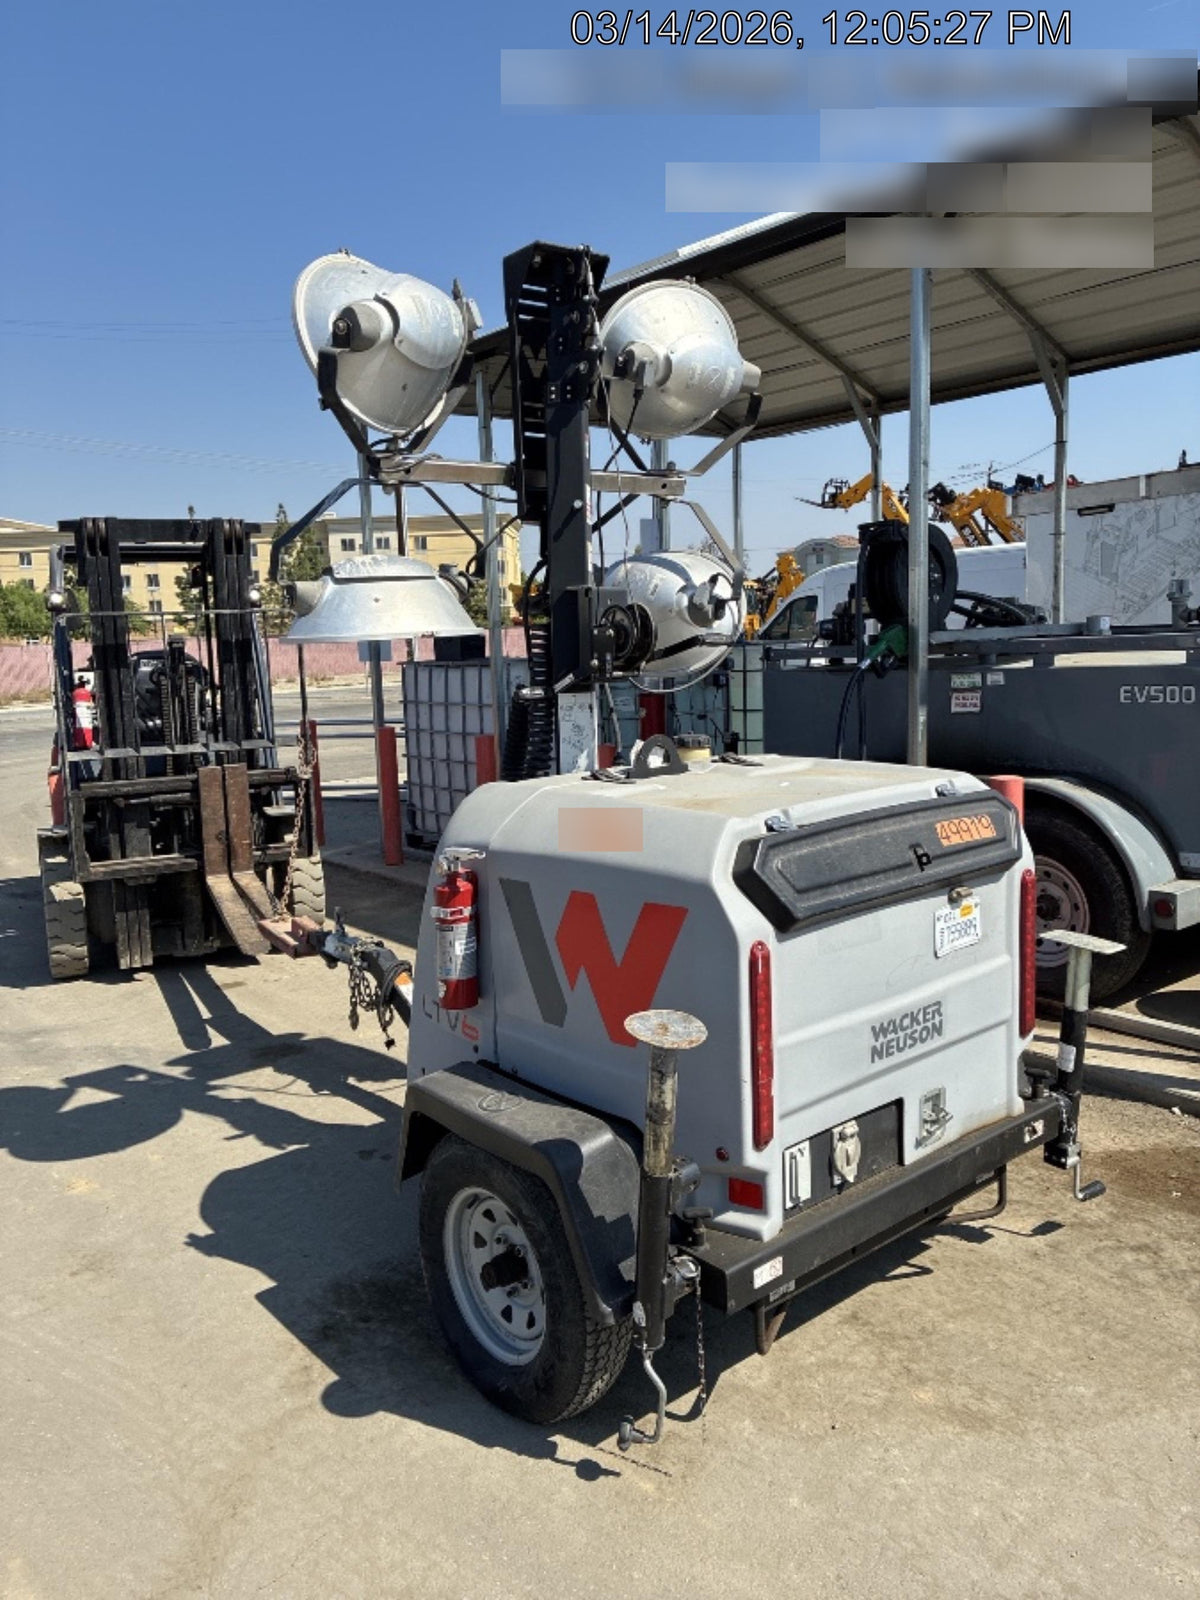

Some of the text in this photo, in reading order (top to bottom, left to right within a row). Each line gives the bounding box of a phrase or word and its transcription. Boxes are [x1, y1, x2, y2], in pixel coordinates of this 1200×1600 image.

[1120, 686, 1195, 703] EV500
[871, 1000, 943, 1042] WACKER
[871, 1018, 943, 1064] NEUSON
